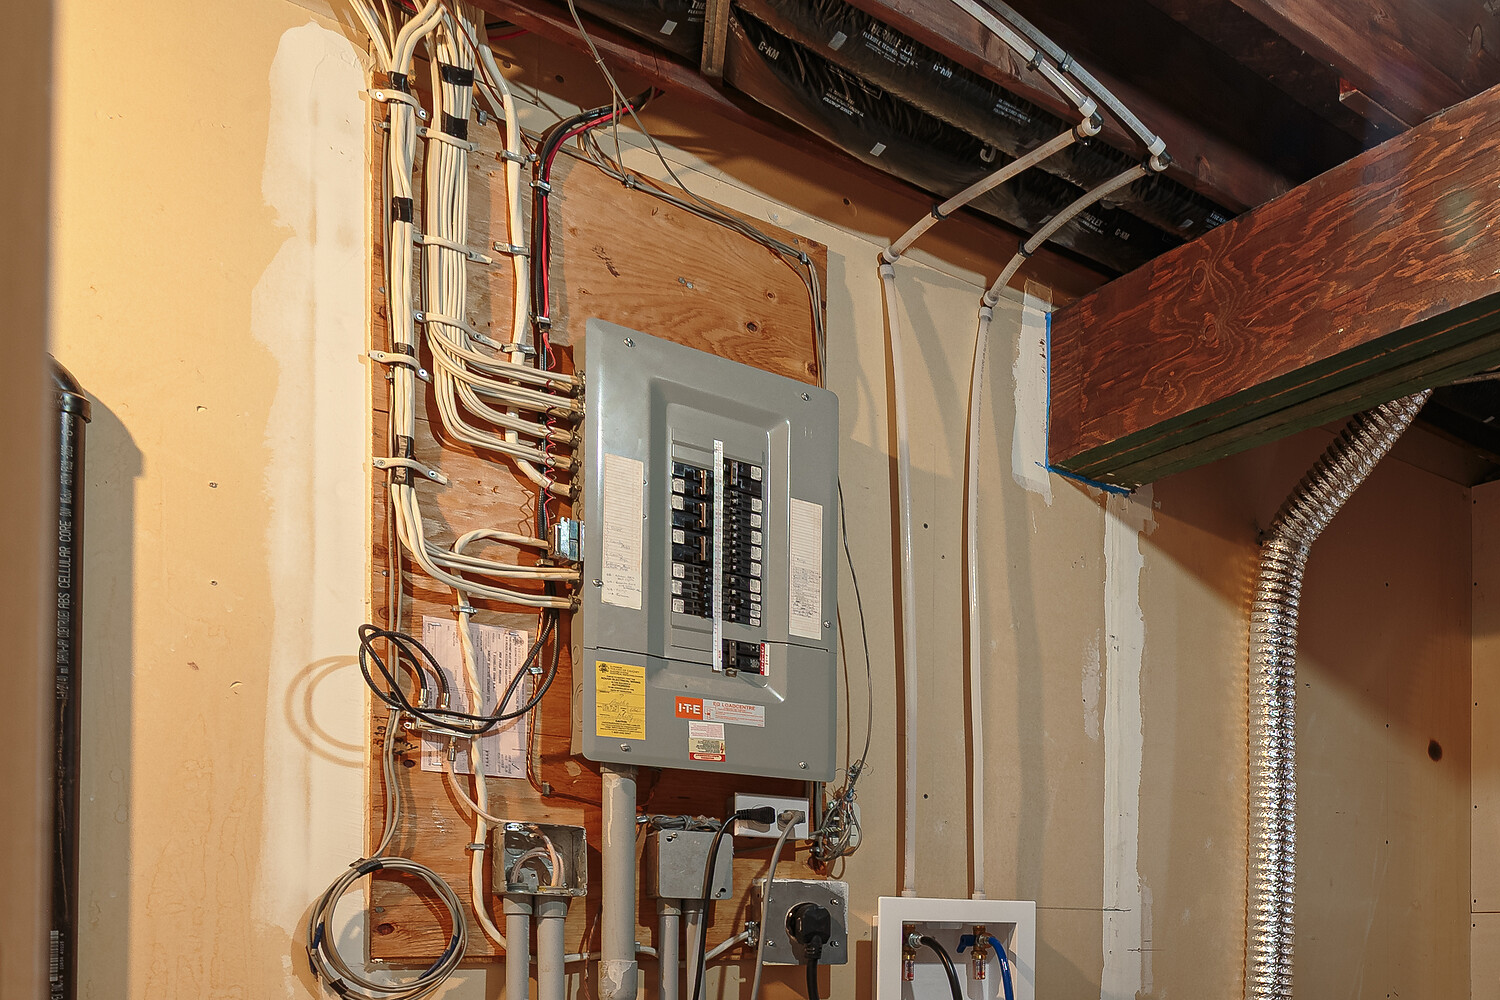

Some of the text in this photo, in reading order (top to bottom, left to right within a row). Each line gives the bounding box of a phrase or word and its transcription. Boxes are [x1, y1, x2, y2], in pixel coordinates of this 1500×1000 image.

[758, 41, 780, 60] G-KM
[58, 520, 72, 542] CORE
[58, 546, 71, 588] CELLULAR
[58, 592, 70, 609] ABS
